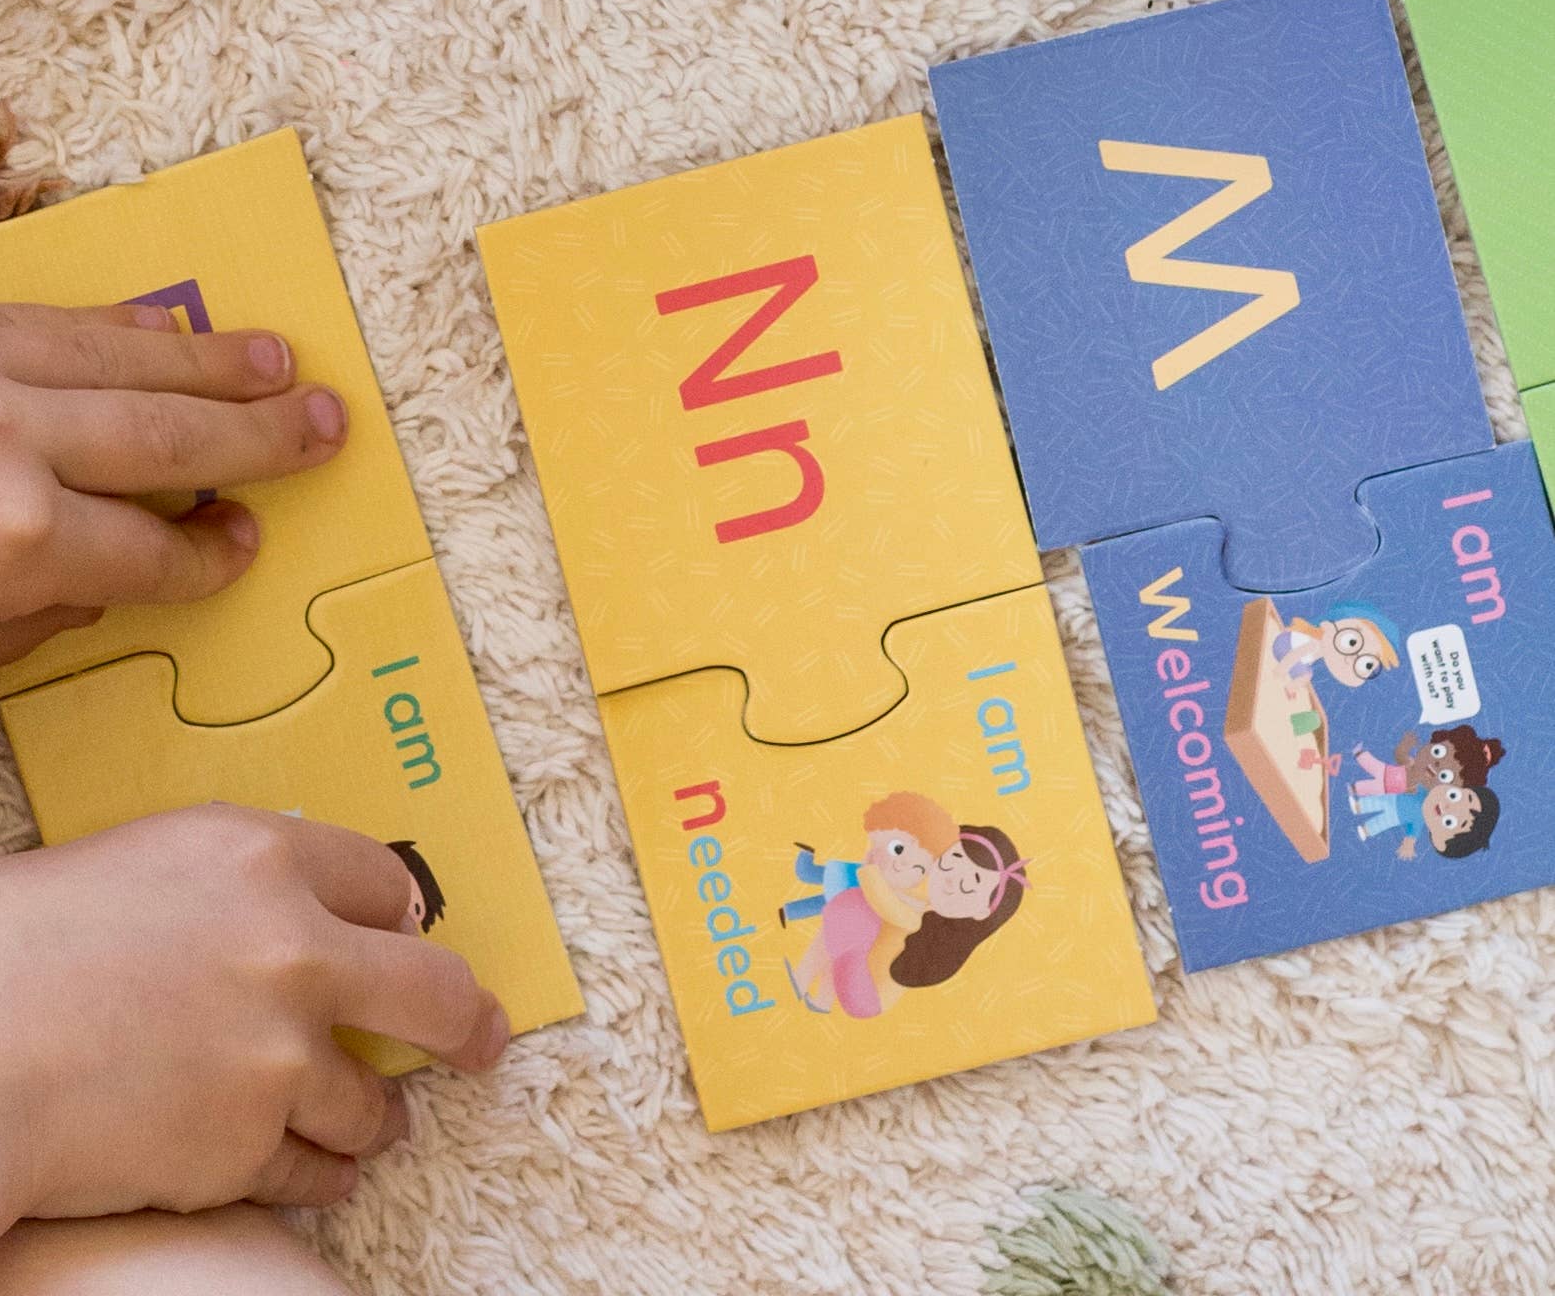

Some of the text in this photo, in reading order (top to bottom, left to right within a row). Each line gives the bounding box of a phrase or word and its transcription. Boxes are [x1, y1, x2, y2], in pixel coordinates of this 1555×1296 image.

[1097, 138, 1300, 392] W
[655, 254, 843, 544] Nn
[1442, 487, 1506, 626] I am
[370, 654, 442, 791] I am
[967, 660, 1033, 798] I am
[1421, 654, 1439, 699] with us?
[1431, 639, 1455, 709] want to play
[1450, 651, 1465, 691] Do you
[673, 779, 775, 1018] needed
